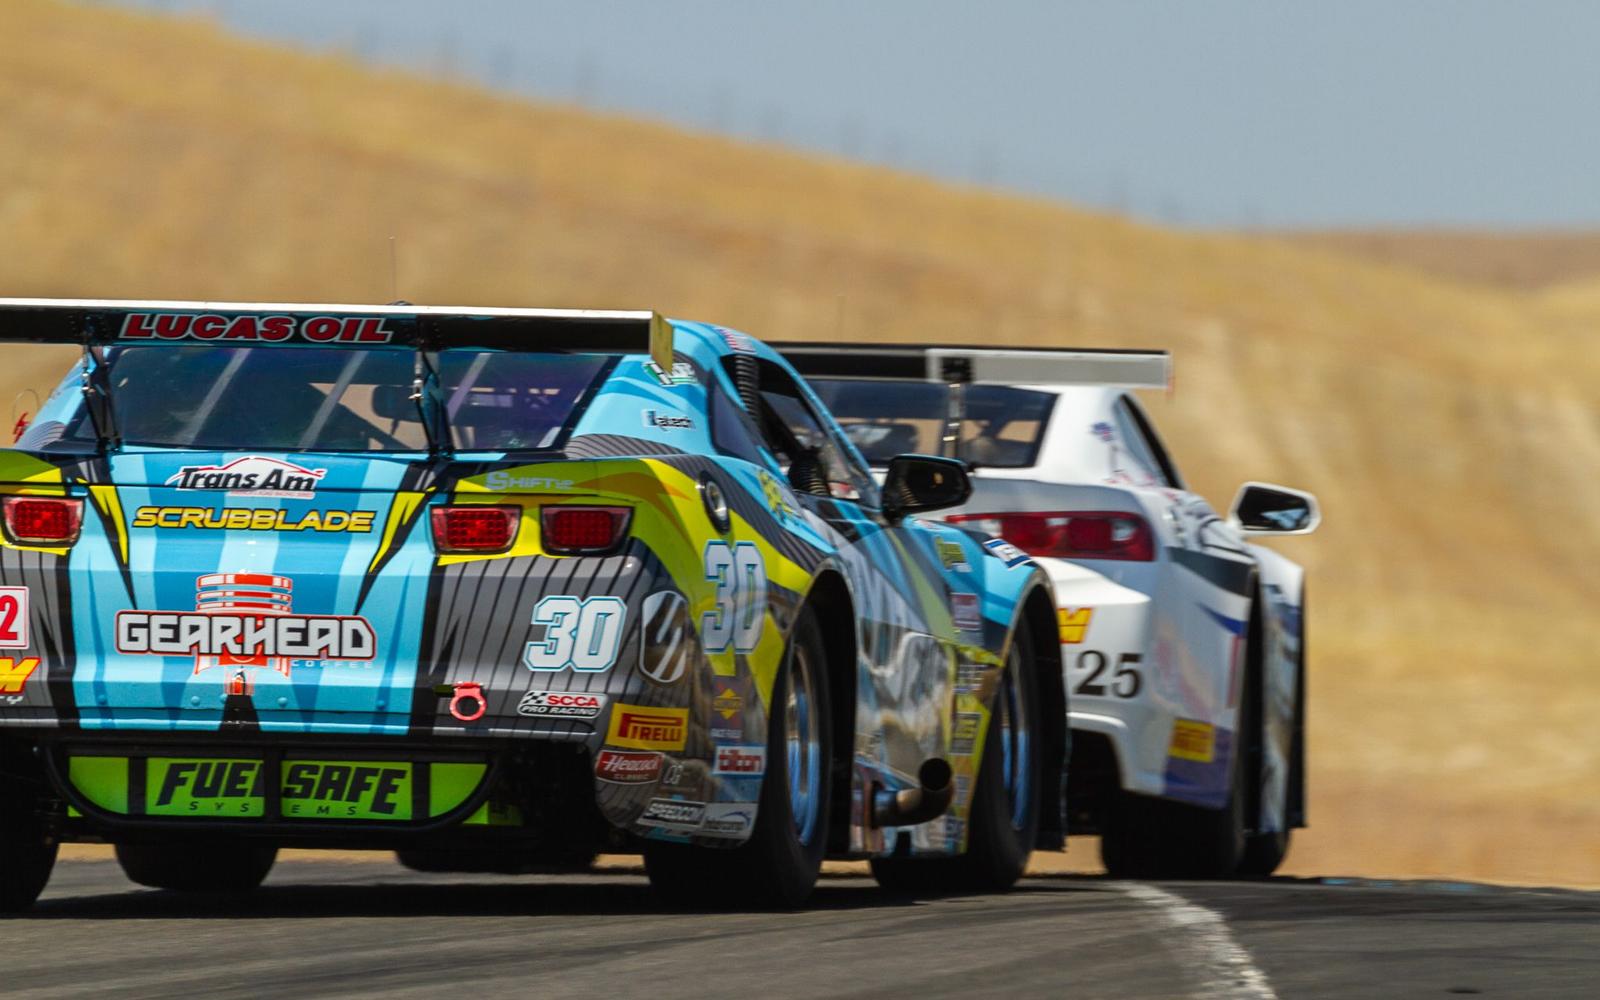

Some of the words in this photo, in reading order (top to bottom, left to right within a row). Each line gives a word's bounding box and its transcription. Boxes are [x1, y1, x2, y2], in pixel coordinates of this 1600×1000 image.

[120, 313, 294, 341] LUCAS
[301, 315, 392, 343] OIL
[178, 467, 259, 489] Trans
[259, 468, 316, 491] Am
[132, 505, 376, 532] SCRUBBLADE
[702, 539, 768, 655] 30
[118, 613, 375, 660] GEARHEAD
[523, 594, 627, 673] 30
[1074, 650, 1144, 699] 25
[521, 705, 548, 714] PRO
[550, 706, 598, 716] RACING
[547, 695, 600, 707] SCCA
[618, 713, 683, 742] PIRELLI
[283, 763, 407, 814] SAFE
